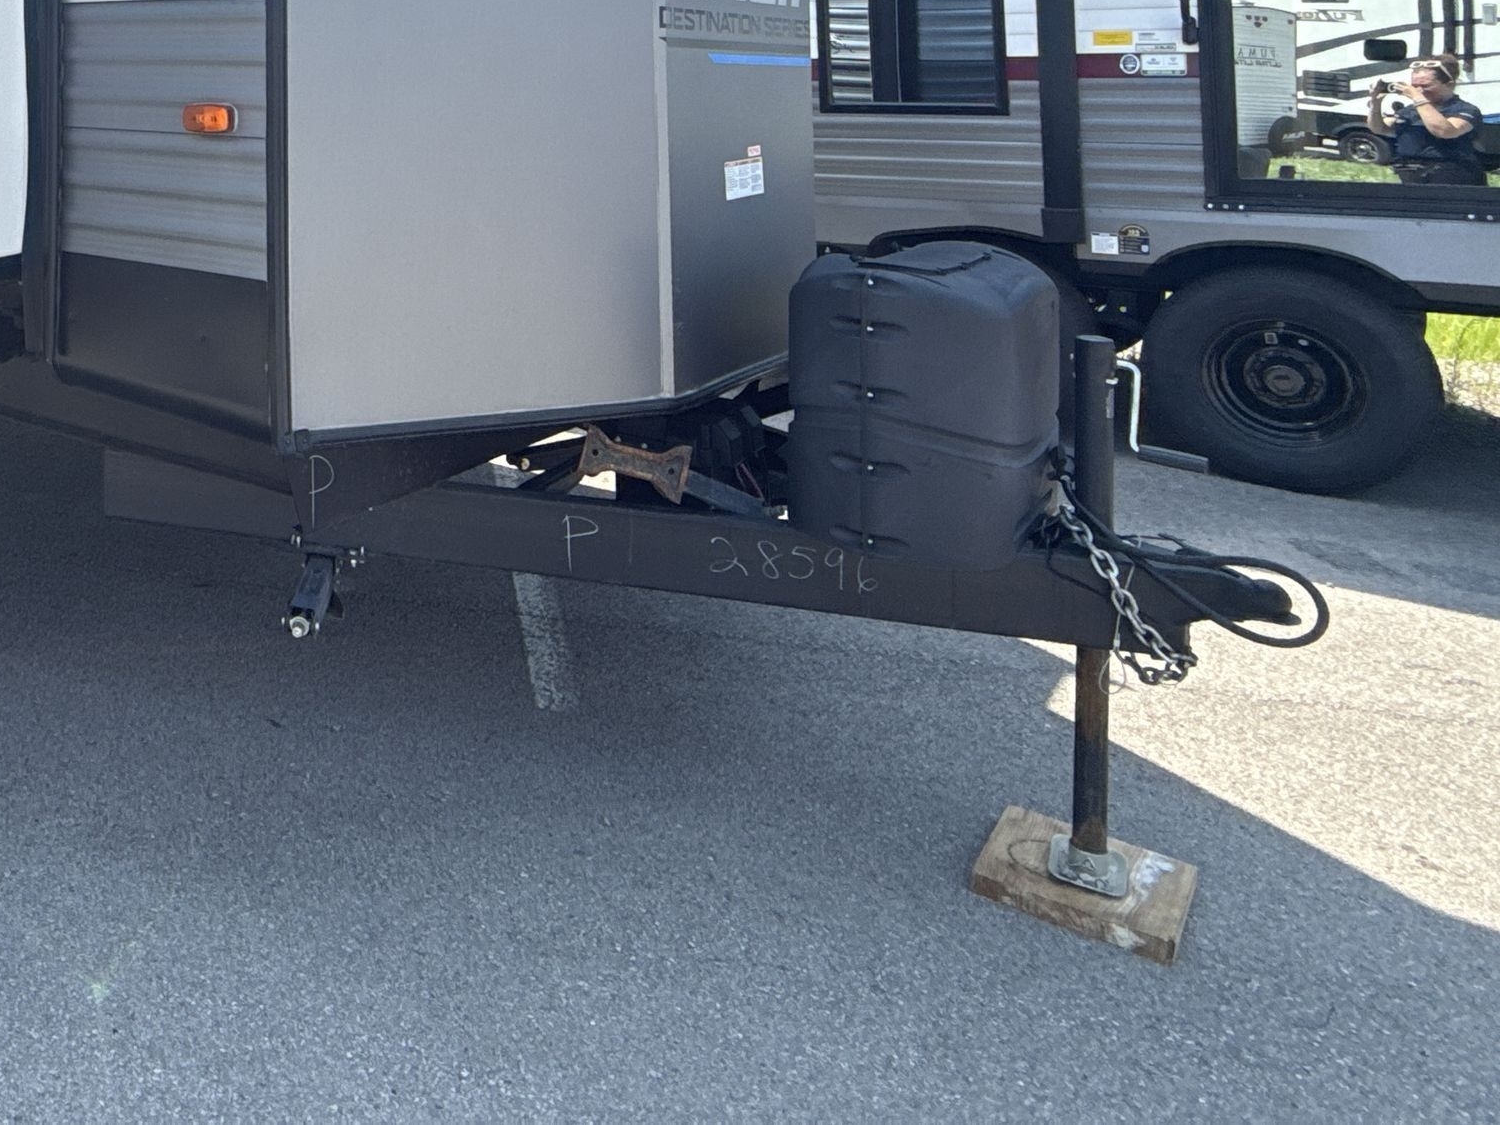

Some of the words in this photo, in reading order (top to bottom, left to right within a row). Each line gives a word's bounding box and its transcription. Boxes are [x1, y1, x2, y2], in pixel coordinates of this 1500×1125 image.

[659, 6, 760, 35] DESTINATION
[764, 17, 810, 39] SERIES
[308, 454, 335, 530] P
[563, 515, 599, 573] P
[709, 536, 879, 595] 28596
